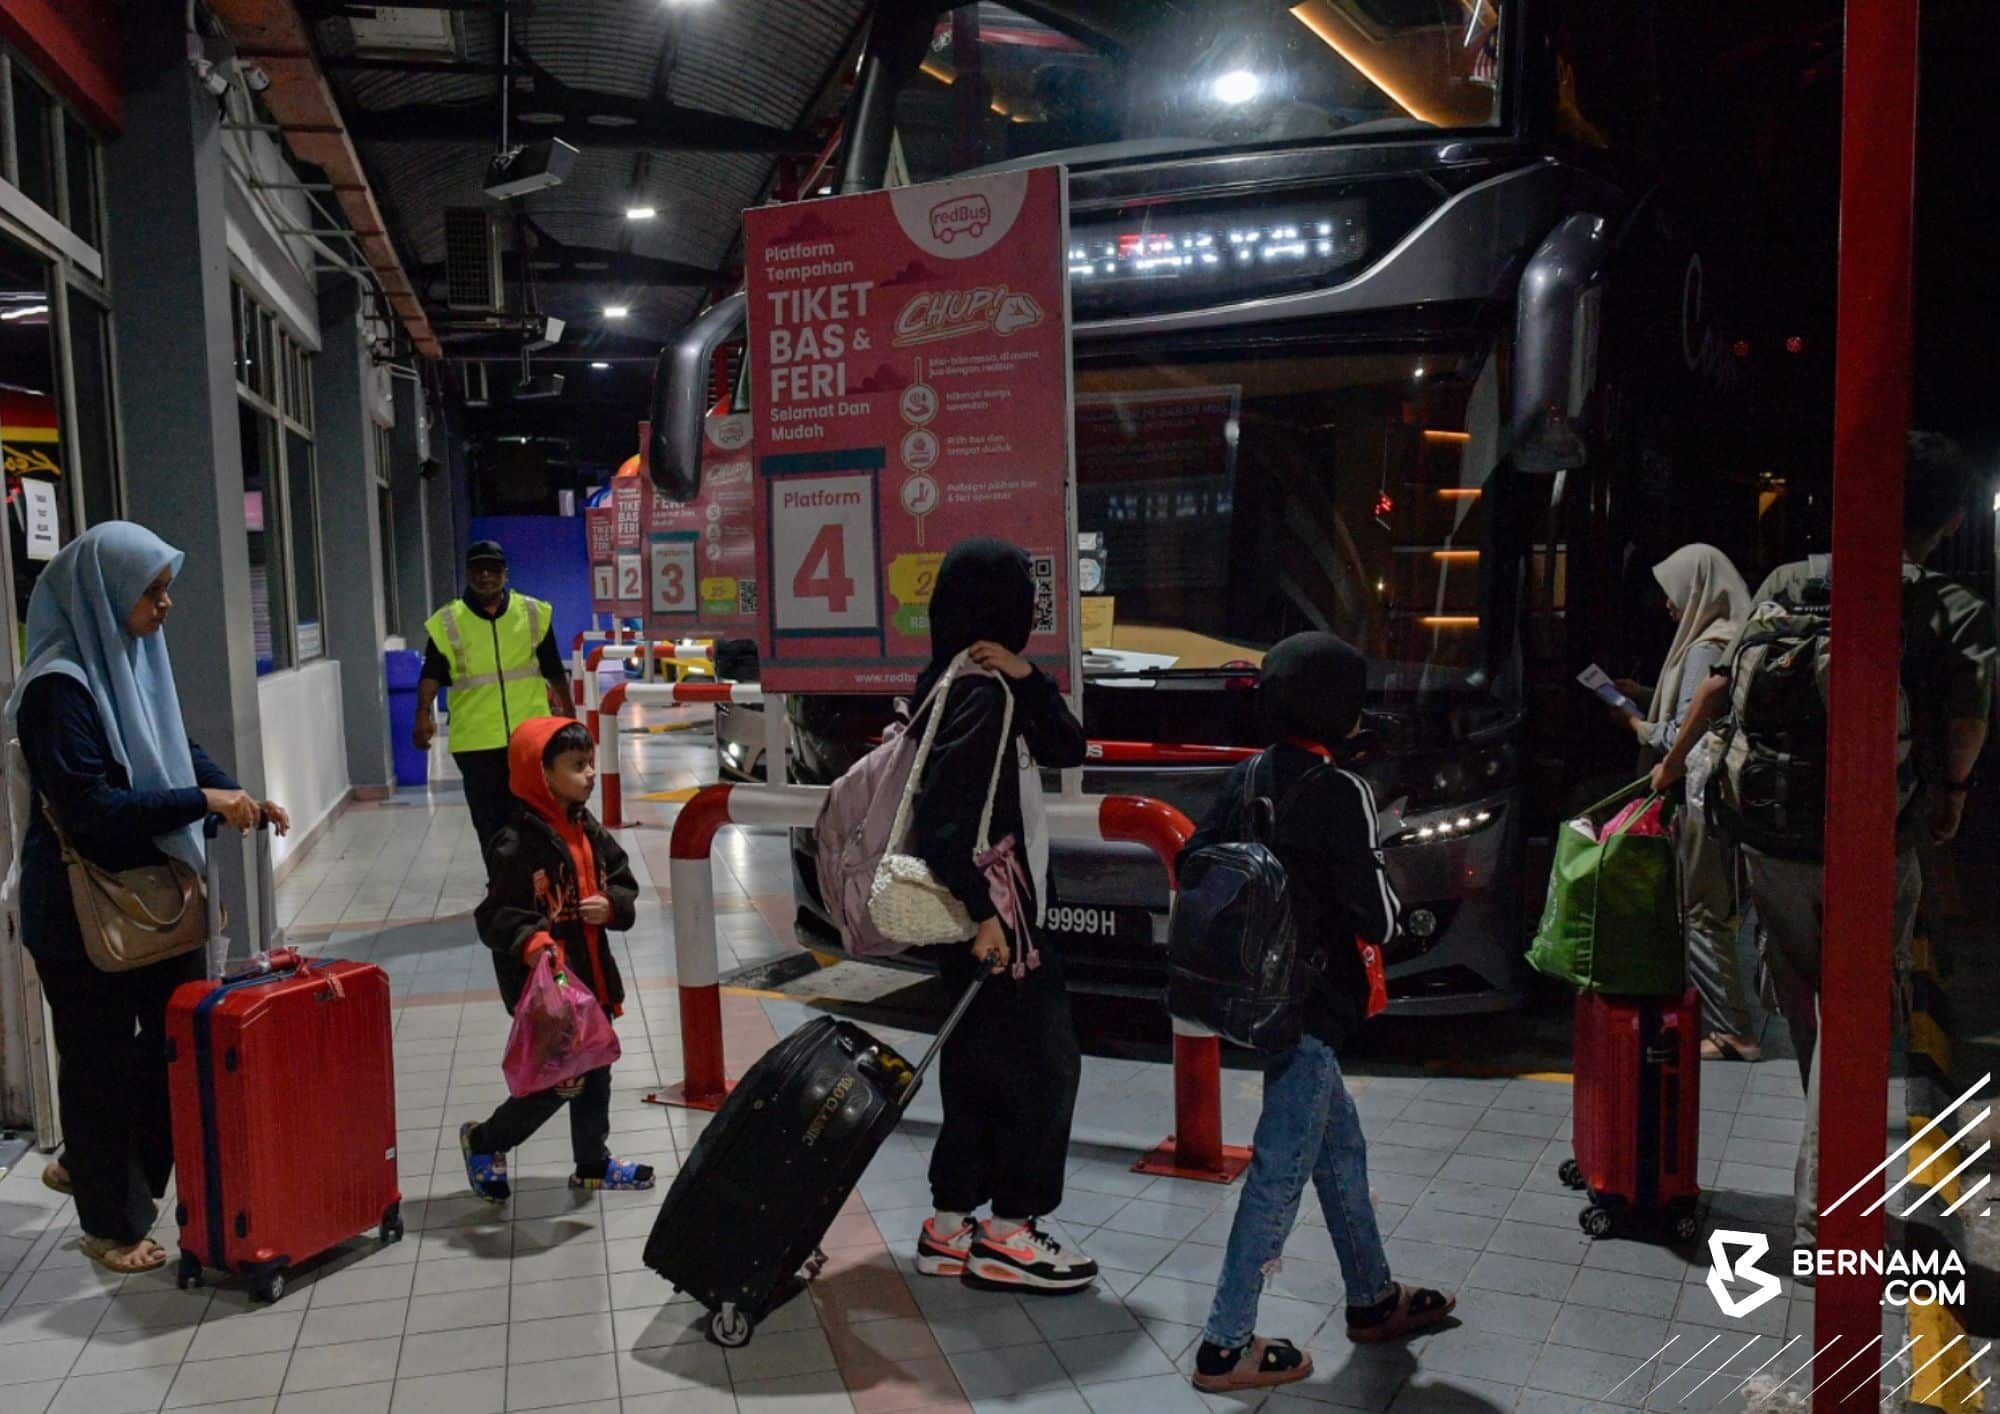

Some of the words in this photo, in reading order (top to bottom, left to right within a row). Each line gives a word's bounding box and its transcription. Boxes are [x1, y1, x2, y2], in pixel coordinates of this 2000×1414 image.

[933, 203, 990, 224] redBus
[764, 241, 835, 261] Platform
[766, 259, 854, 282] Tempahan
[767, 281, 874, 325] TIKET
[769, 323, 845, 364] BAS
[852, 328, 872, 350] &
[771, 362, 846, 402] FERI
[770, 403, 834, 422] Selamat
[838, 401, 870, 417] Dan
[771, 424, 823, 441] Mudah
[783, 489, 861, 509] Platform
[793, 524, 856, 613] 4
[600, 576, 608, 597] 1
[625, 567, 640, 594] 2
[661, 563, 684, 605] 3
